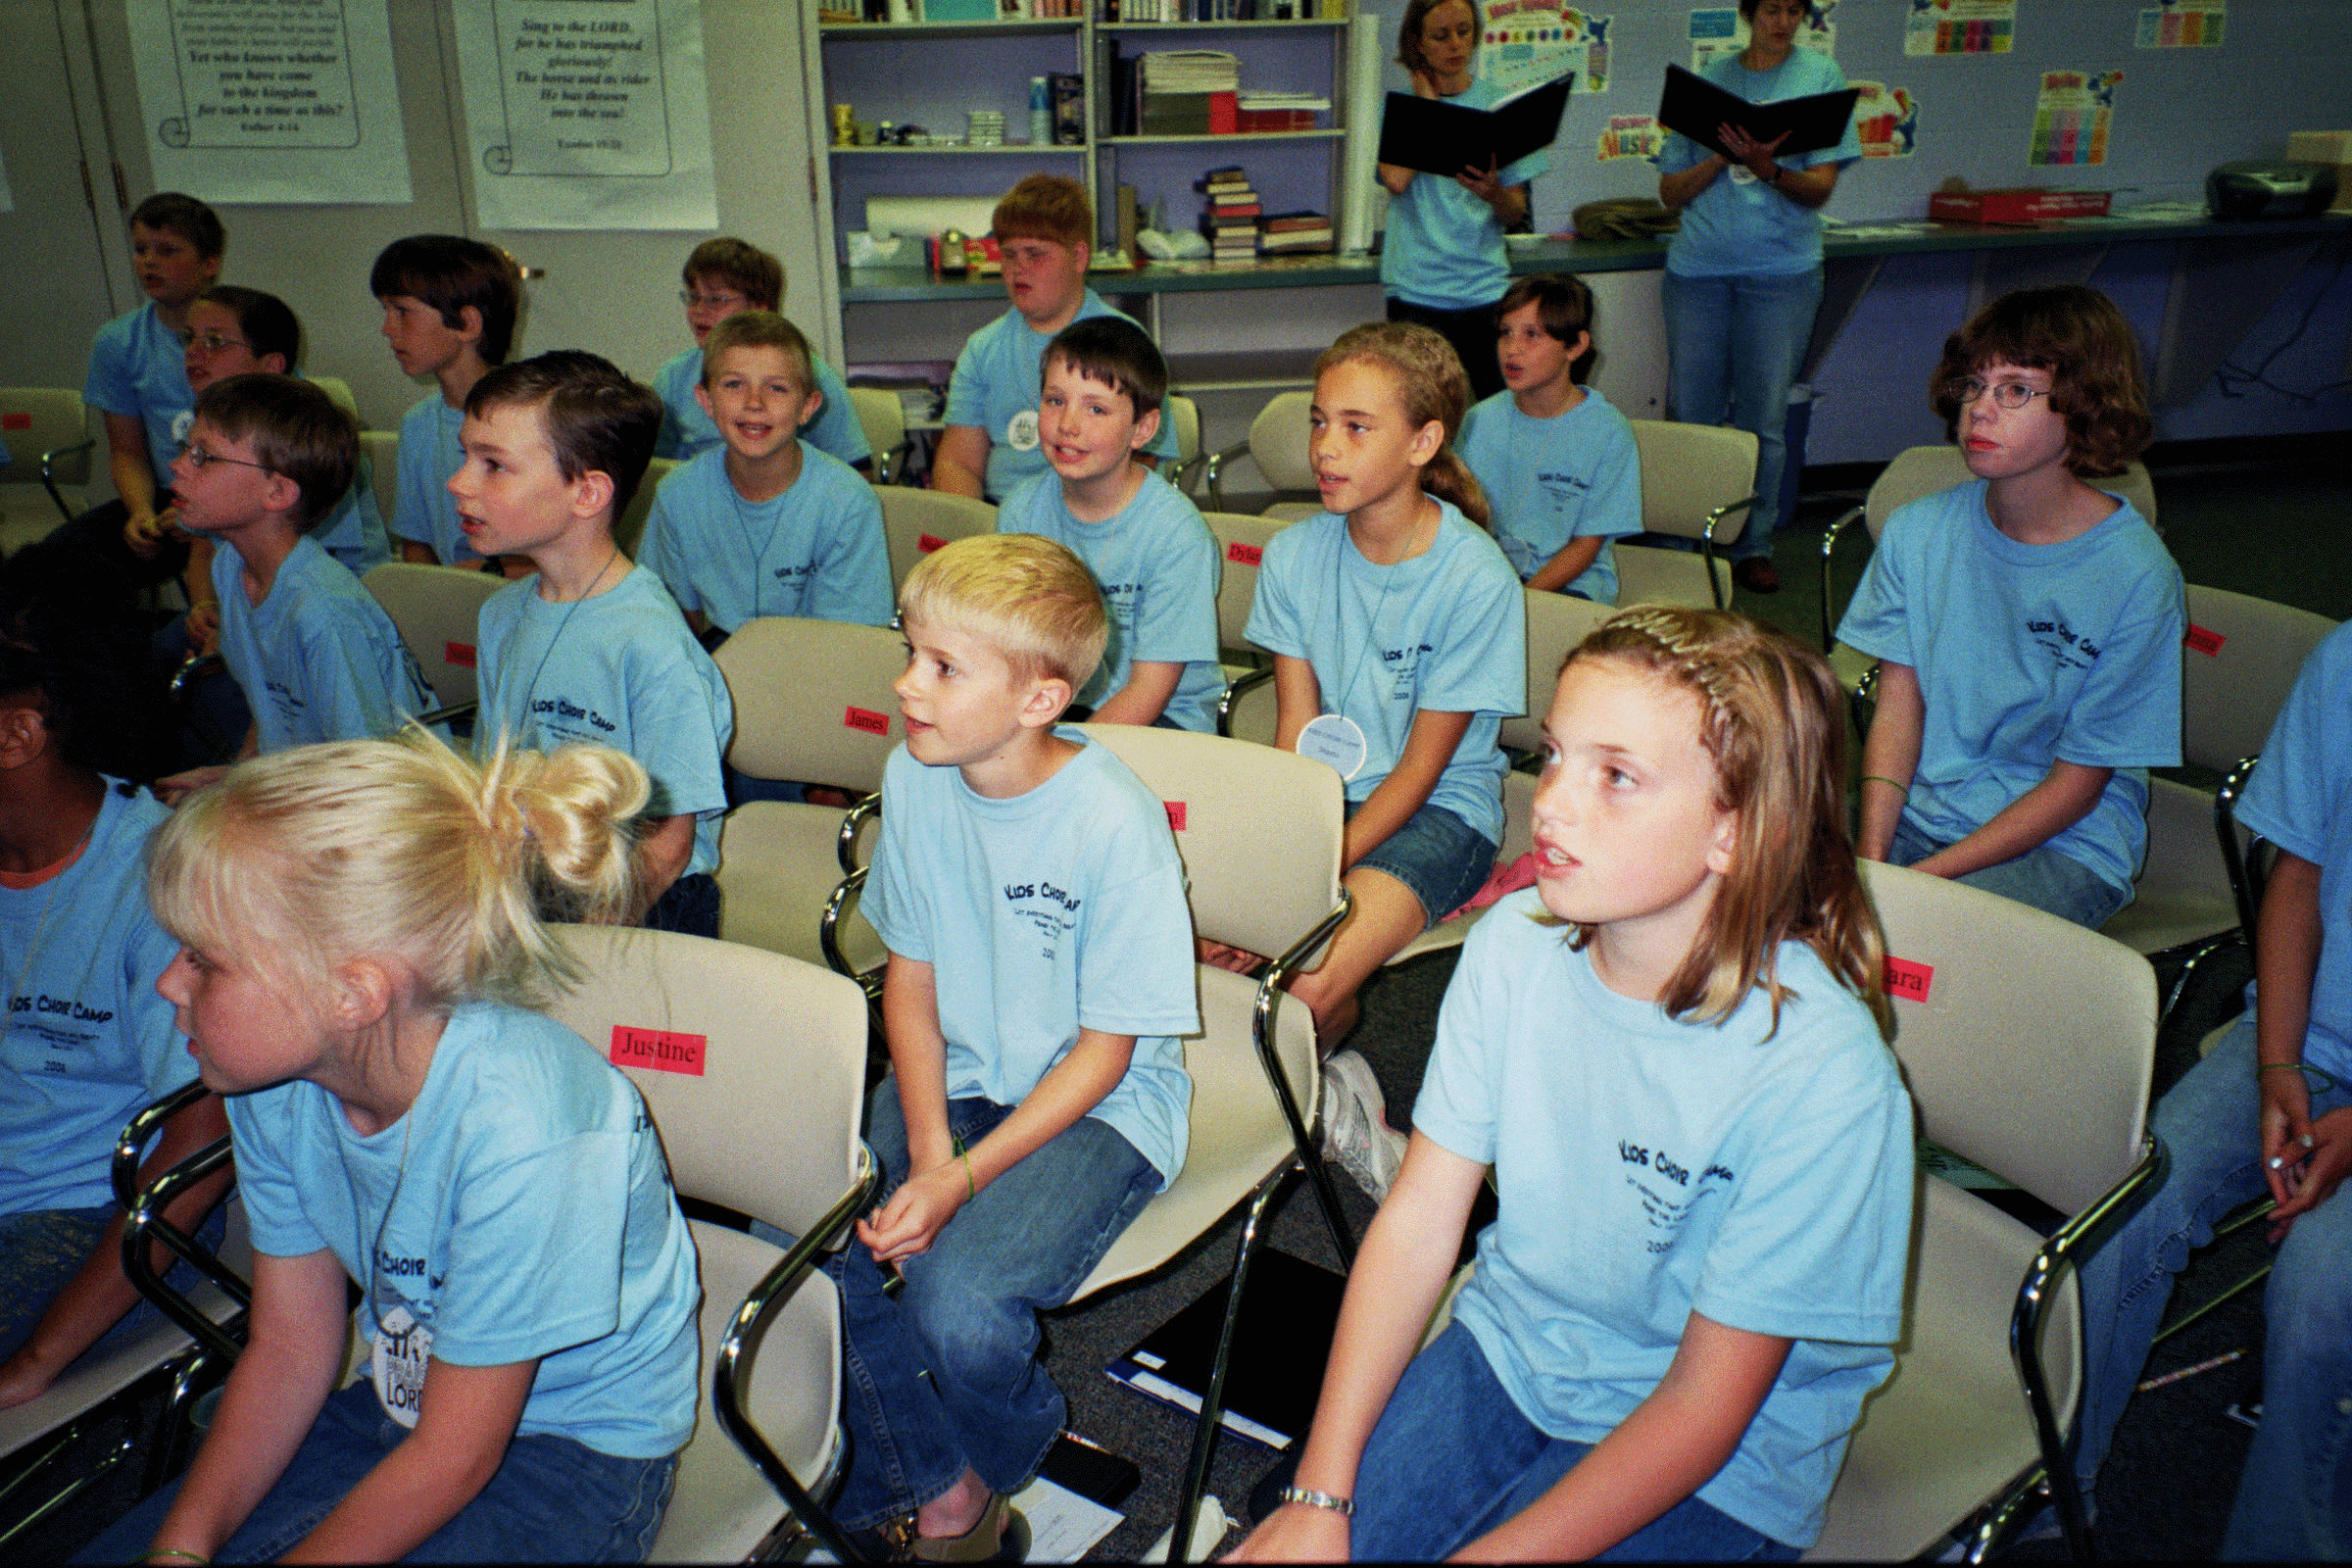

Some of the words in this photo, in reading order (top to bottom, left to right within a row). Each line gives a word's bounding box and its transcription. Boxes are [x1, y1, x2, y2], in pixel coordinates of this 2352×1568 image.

[849, 710, 884, 731] James
[37, 994, 72, 1015] CHOIR
[74, 1002, 114, 1024] CAMP
[620, 1032, 696, 1063] Justine
[1654, 1150, 1690, 1187] CHOIR
[382, 1250, 426, 1276] CHOIR
